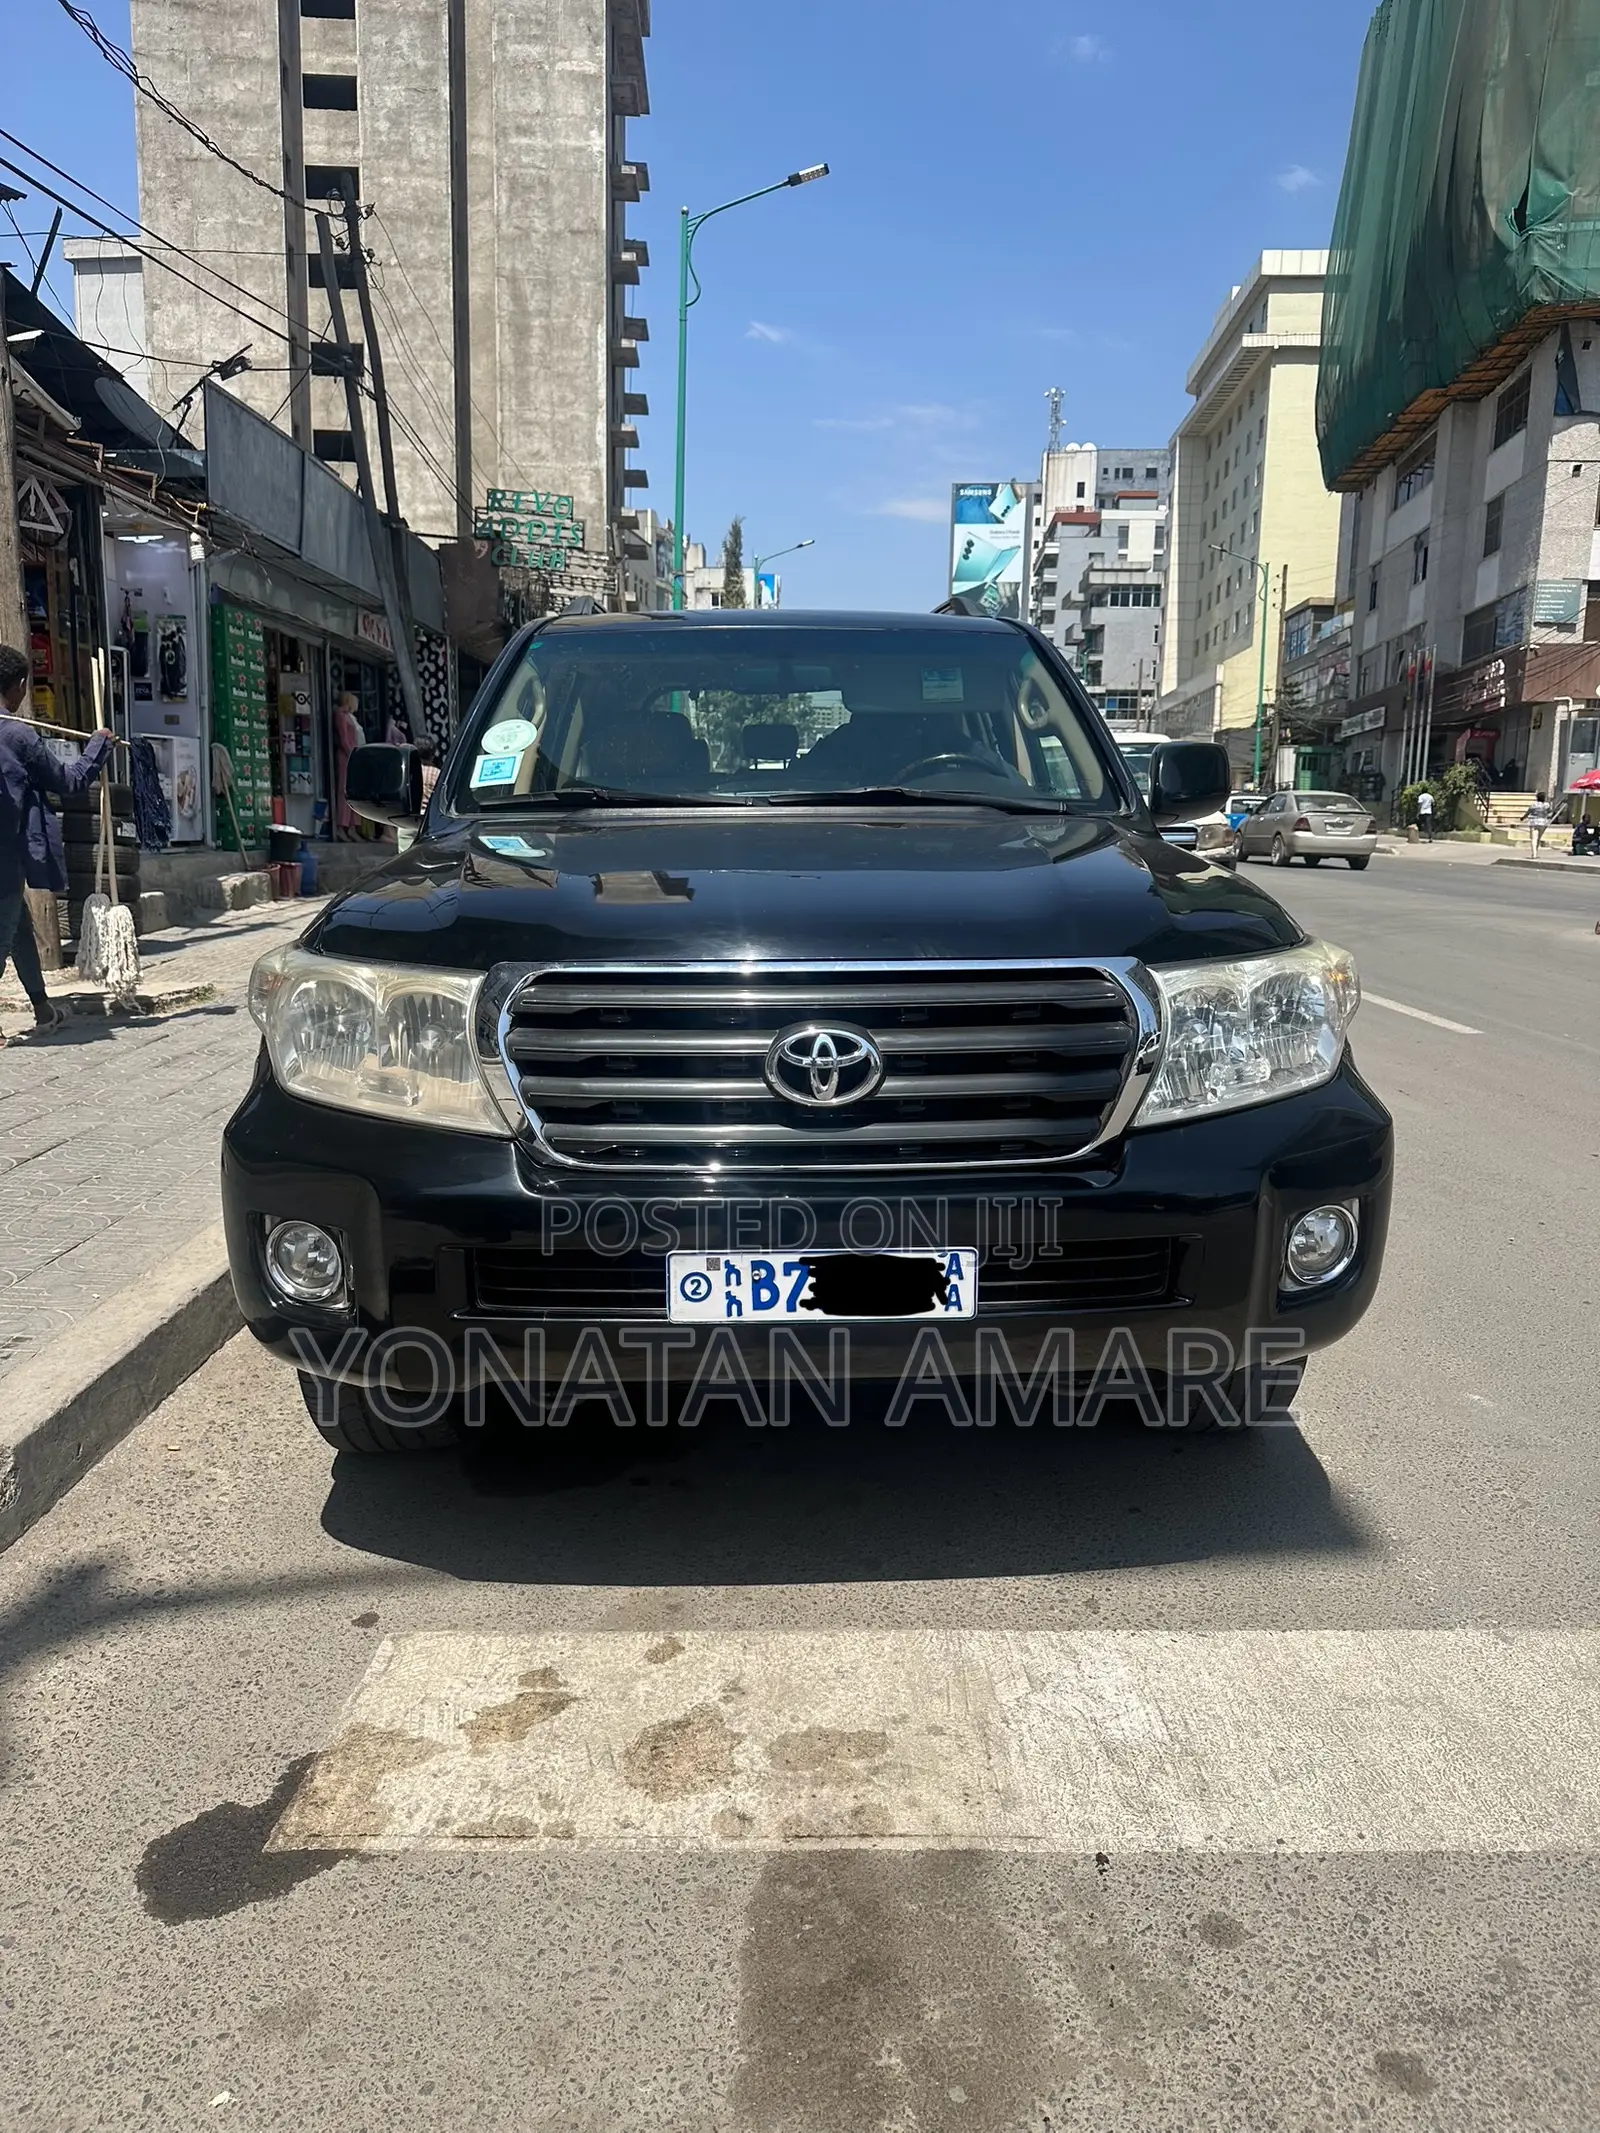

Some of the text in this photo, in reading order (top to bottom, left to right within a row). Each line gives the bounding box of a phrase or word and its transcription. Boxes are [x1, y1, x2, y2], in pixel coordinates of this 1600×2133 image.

[489, 489, 571, 520] REVO
[476, 517, 583, 545] ADDIS
[491, 544, 565, 569] CLUB
